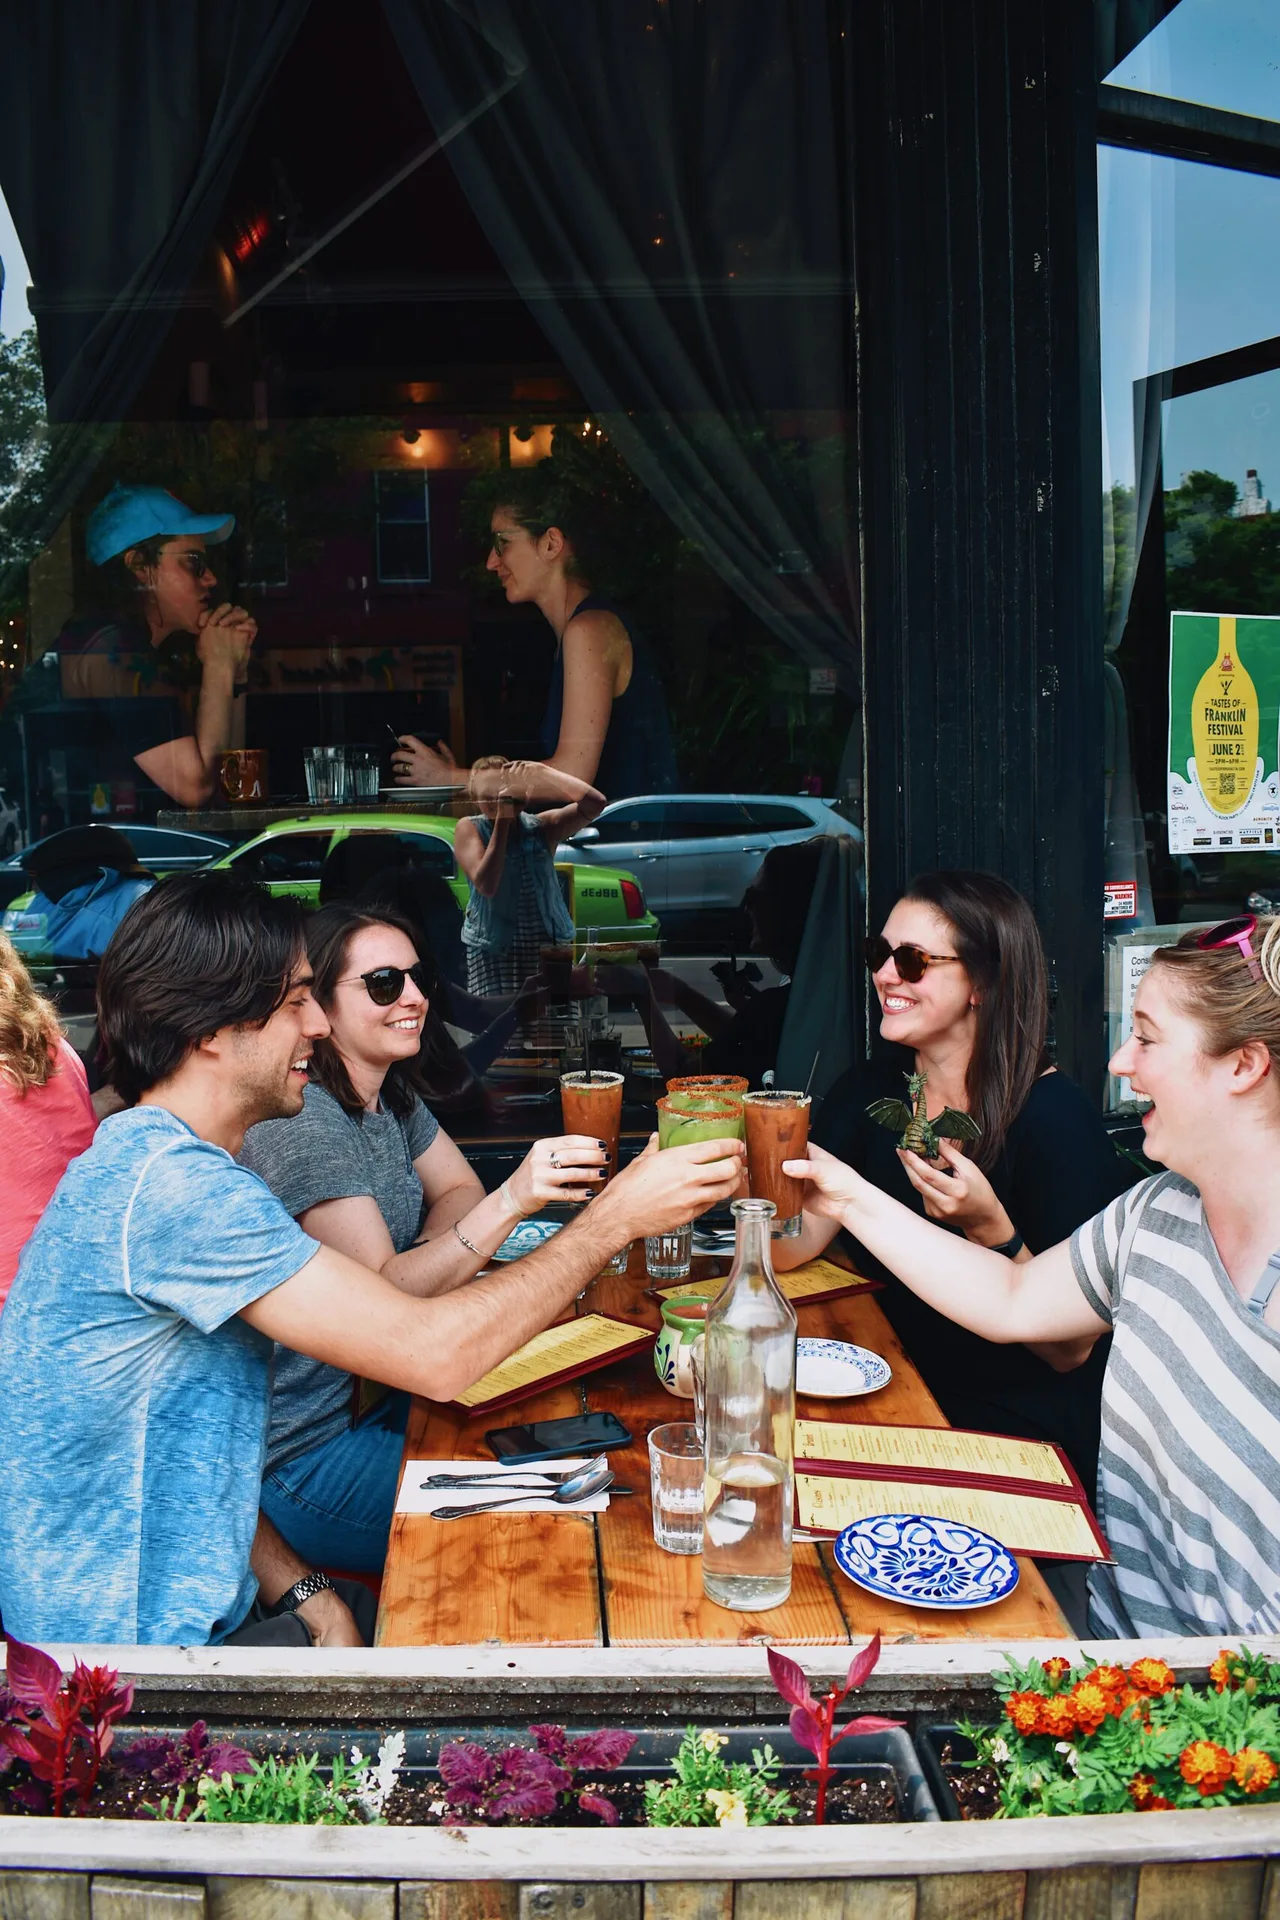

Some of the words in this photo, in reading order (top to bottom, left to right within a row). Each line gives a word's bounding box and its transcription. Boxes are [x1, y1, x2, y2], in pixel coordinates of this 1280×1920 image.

[1211, 698, 1231, 708] TASTES
[1232, 699, 1241, 707] OF
[1205, 708, 1246, 721] FRANKLIN
[1208, 724, 1243, 735] FESTIVAL
[1212, 744, 1234, 755] JUNE
[1131, 968, 1147, 977] Lice
